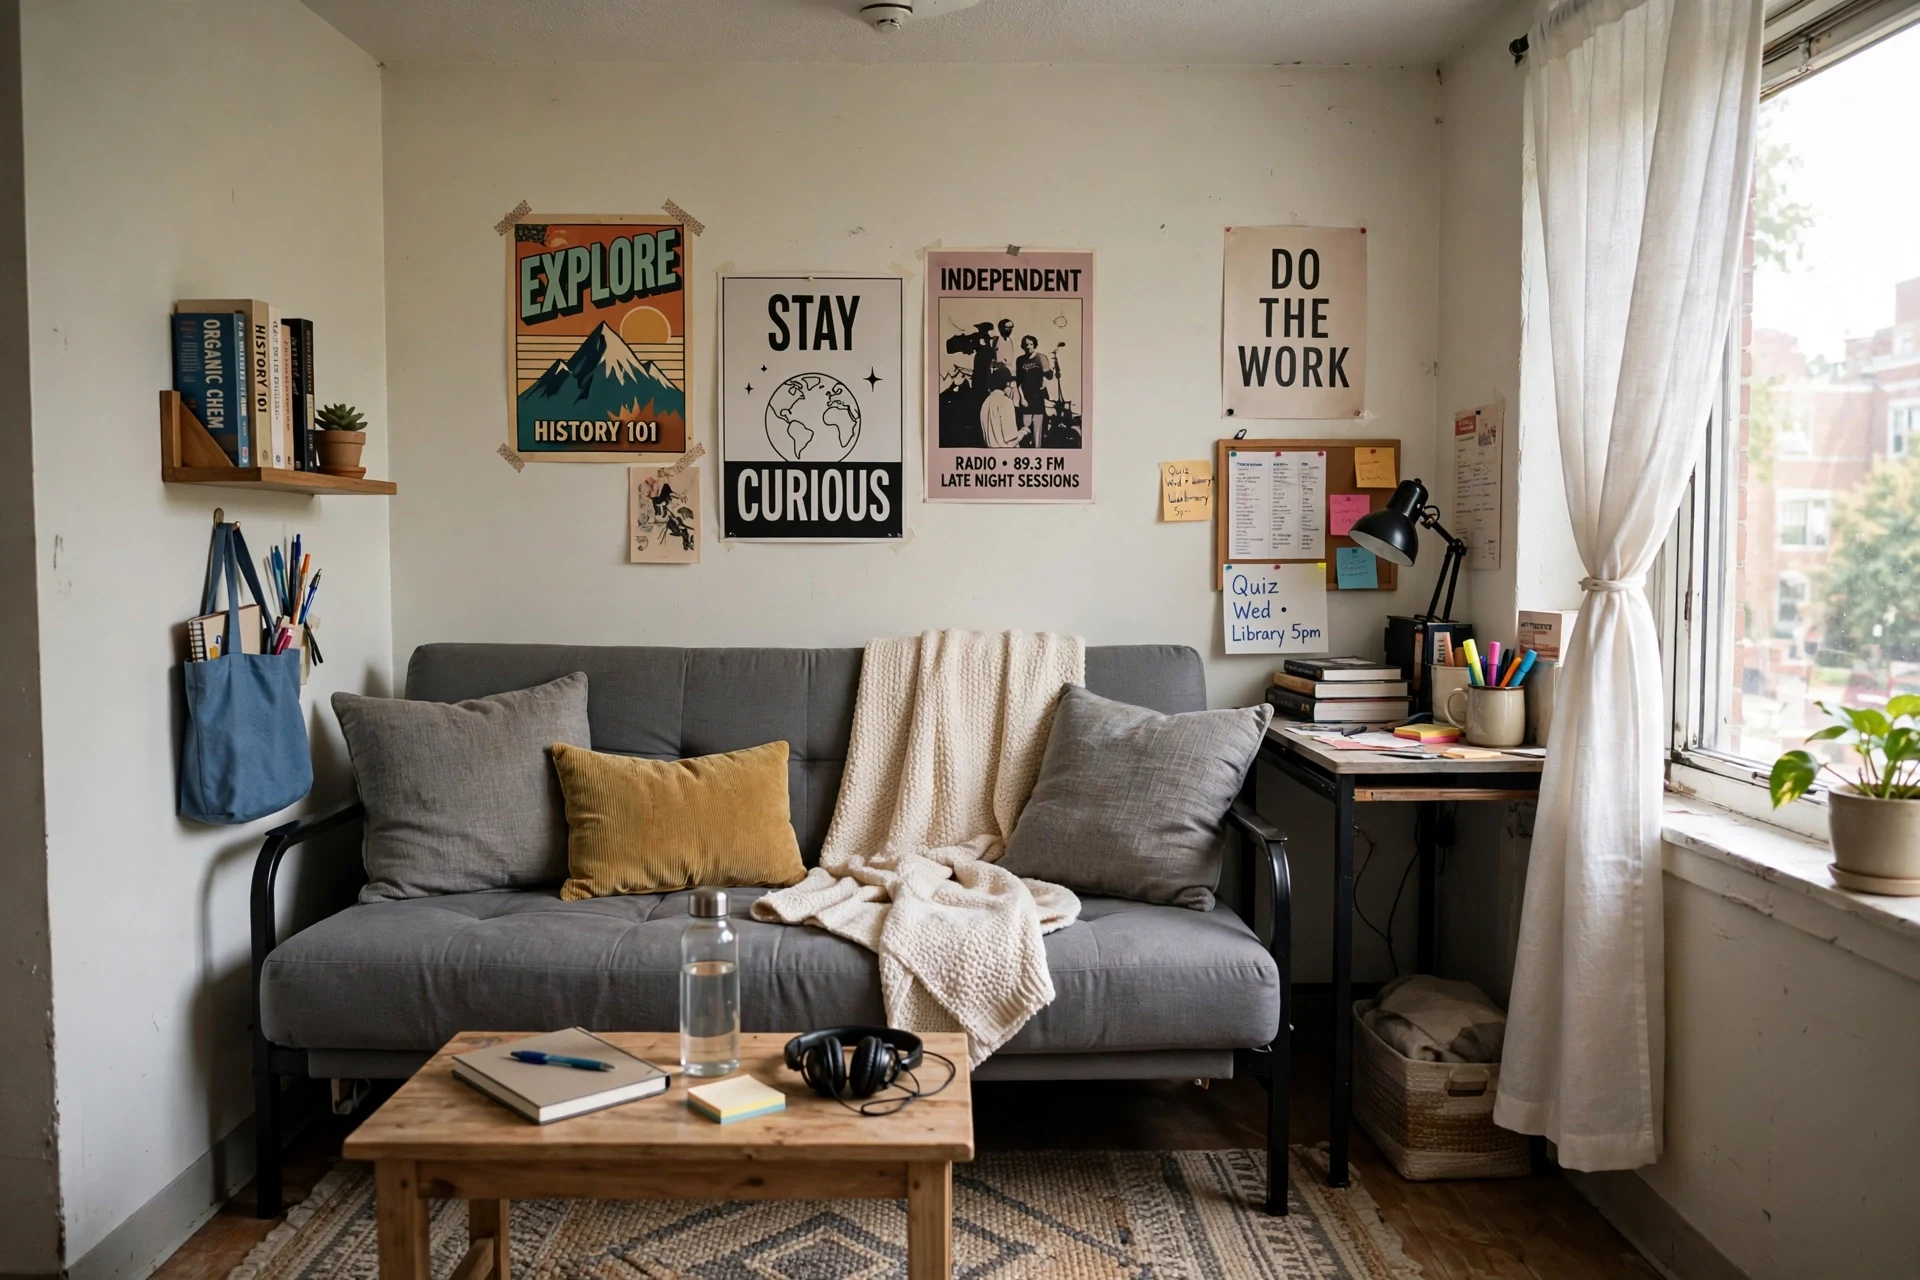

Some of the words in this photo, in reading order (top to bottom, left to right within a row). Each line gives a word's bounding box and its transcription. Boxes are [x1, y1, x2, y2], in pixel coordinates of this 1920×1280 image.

[521, 228, 681, 325] EXPLORE
[941, 268, 1082, 292] INDEPENDENT
[1271, 248, 1320, 290] DO
[768, 293, 861, 352] STAY
[1259, 298, 1330, 338] THE
[203, 319, 223, 384] ORGANIC
[255, 324, 268, 389] HISTORY
[1238, 345, 1350, 388] WORK
[206, 389, 225, 429] CHEM
[257, 391, 268, 413] 101
[534, 420, 621, 442] HISTORY
[626, 421, 658, 442] 101
[941, 473, 971, 488] LATE
[975, 473, 1015, 488] NIGHT
[1018, 473, 1080, 488] SESSIONS
[955, 456, 997, 471] RADIO
[1013, 457, 1043, 471] 89.3
[1046, 456, 1065, 471] FM
[737, 468, 891, 523] CURIOUS
[1232, 574, 1280, 597] Quiz
[1233, 600, 1271, 620] Wed
[1232, 624, 1285, 648] Library
[1291, 623, 1321, 644] 5pm
